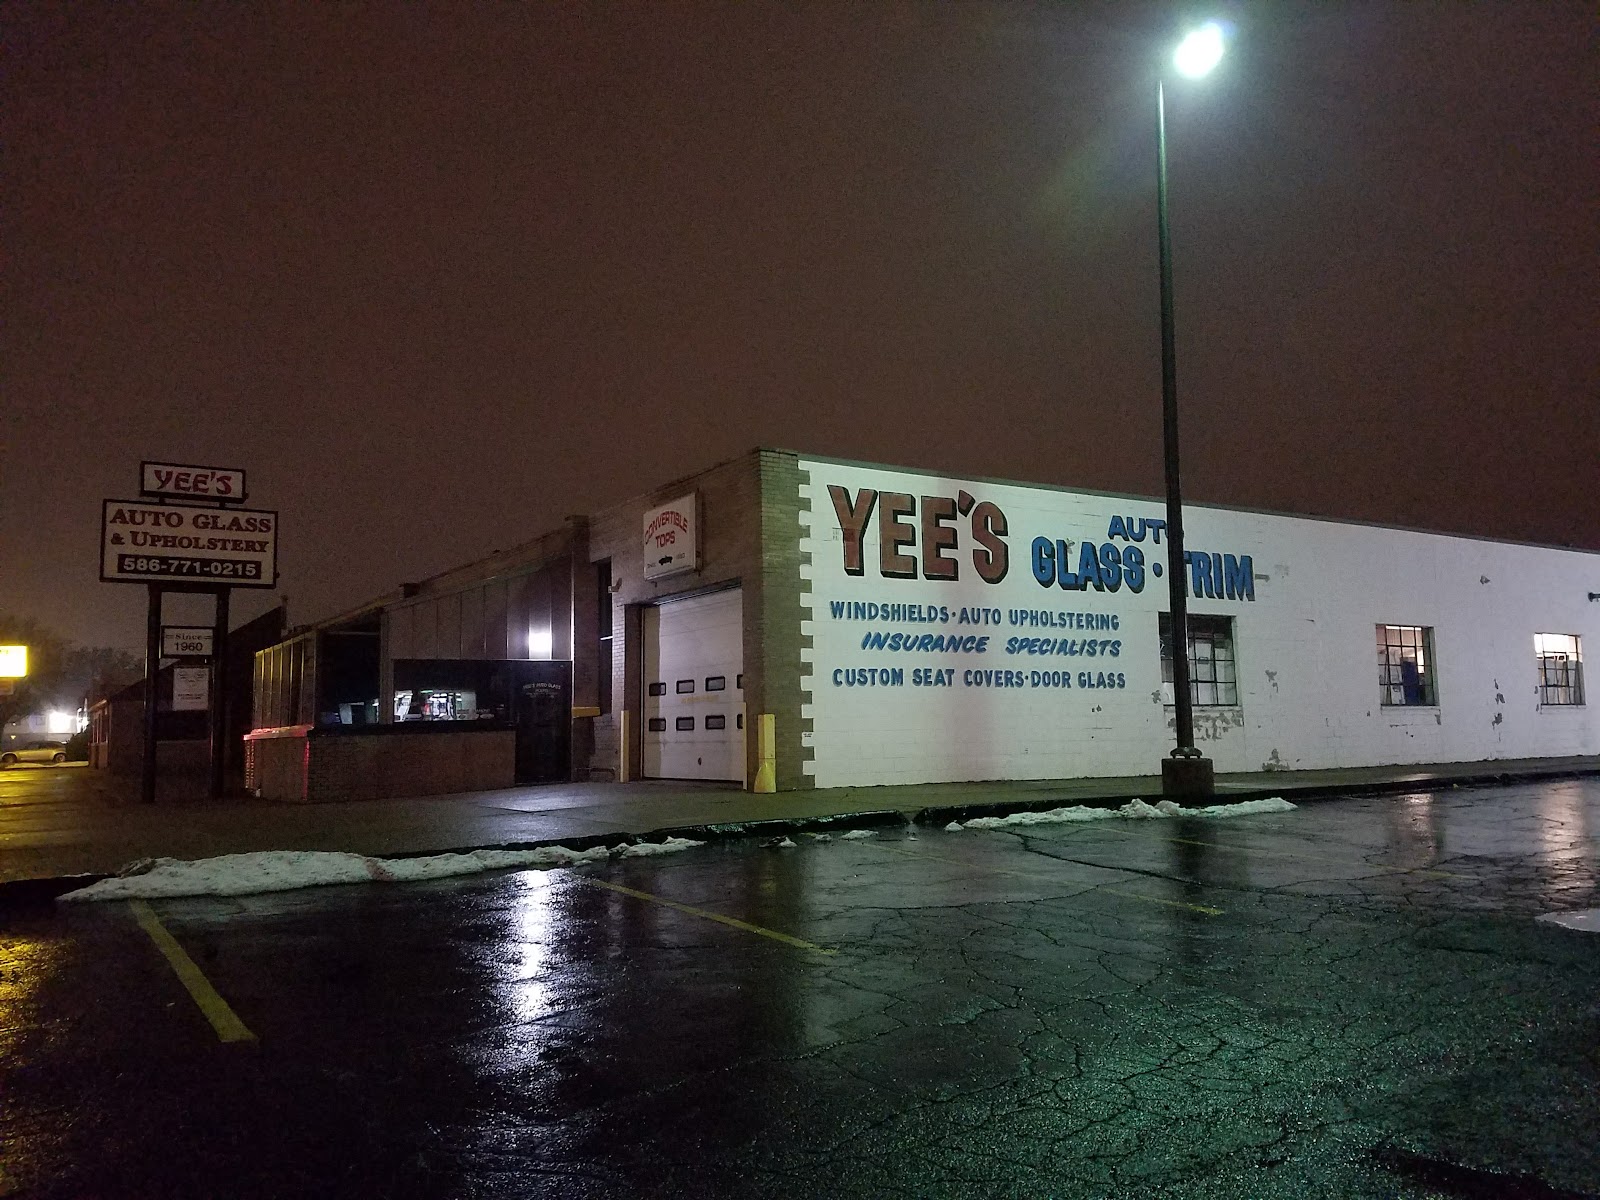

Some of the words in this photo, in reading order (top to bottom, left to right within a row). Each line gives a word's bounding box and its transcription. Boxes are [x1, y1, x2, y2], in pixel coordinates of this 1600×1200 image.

[154, 470, 232, 495] YEE'S
[110, 509, 184, 528] AUTO
[192, 514, 272, 533] GLASS
[645, 511, 689, 545] CONVERTIBLE
[1108, 515, 1184, 544] AUT
[111, 533, 125, 546] &
[129, 531, 270, 553] UPHOLSTERY
[655, 530, 675, 549] TOPS
[826, 484, 1010, 584] YEE'S
[123, 558, 257, 577] 586-771-0215
[1031, 535, 1146, 594] GLASS
[1009, 609, 1120, 631] UPHOLSTERING
[174, 642, 203, 652] 1960
[861, 631, 990, 653] INSURANCE
[1005, 636, 1122, 657] SPECIALISTS
[832, 667, 904, 688] CUSTOM
[912, 668, 955, 687] SEAT
[1077, 671, 1126, 690] GLASS
